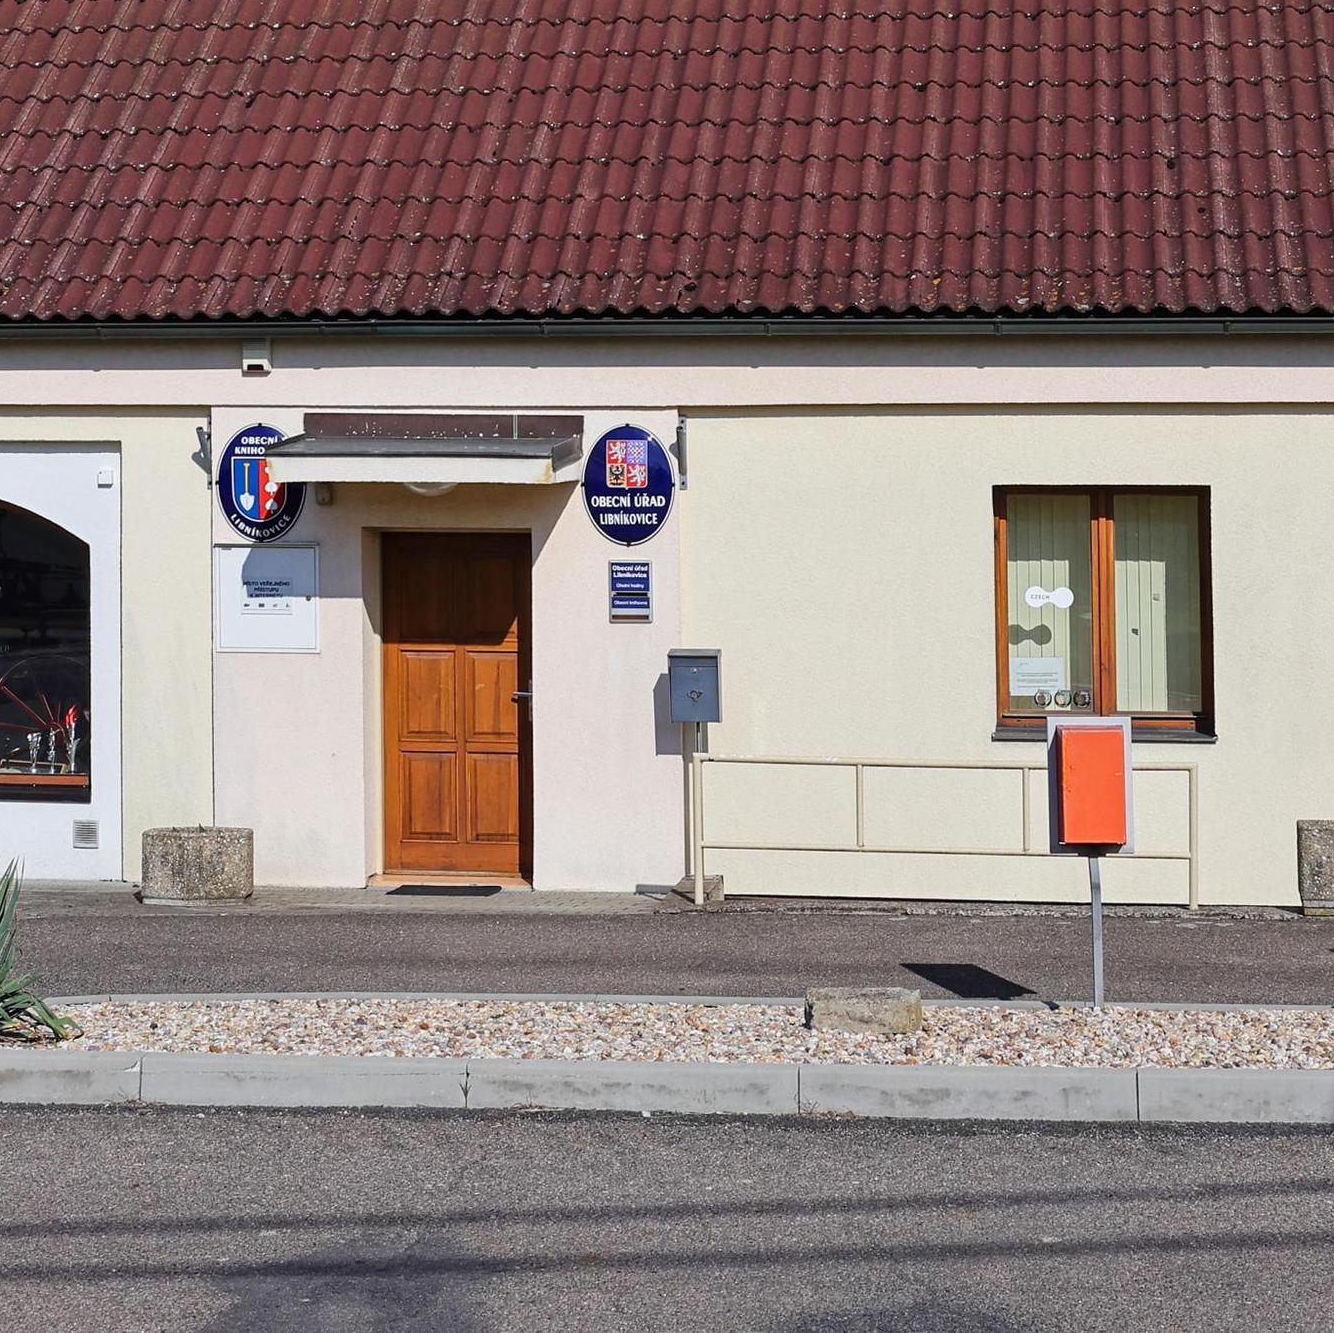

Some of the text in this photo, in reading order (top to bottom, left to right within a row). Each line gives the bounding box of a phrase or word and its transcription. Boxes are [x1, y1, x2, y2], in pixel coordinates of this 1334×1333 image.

[241, 435, 278, 445] OBECNÍ
[591, 493, 666, 507] OBECNÍ ÚŘAD
[599, 510, 658, 525] LIBNÍKOVICE
[230, 514, 291, 537] LIBNÍKOVICE
